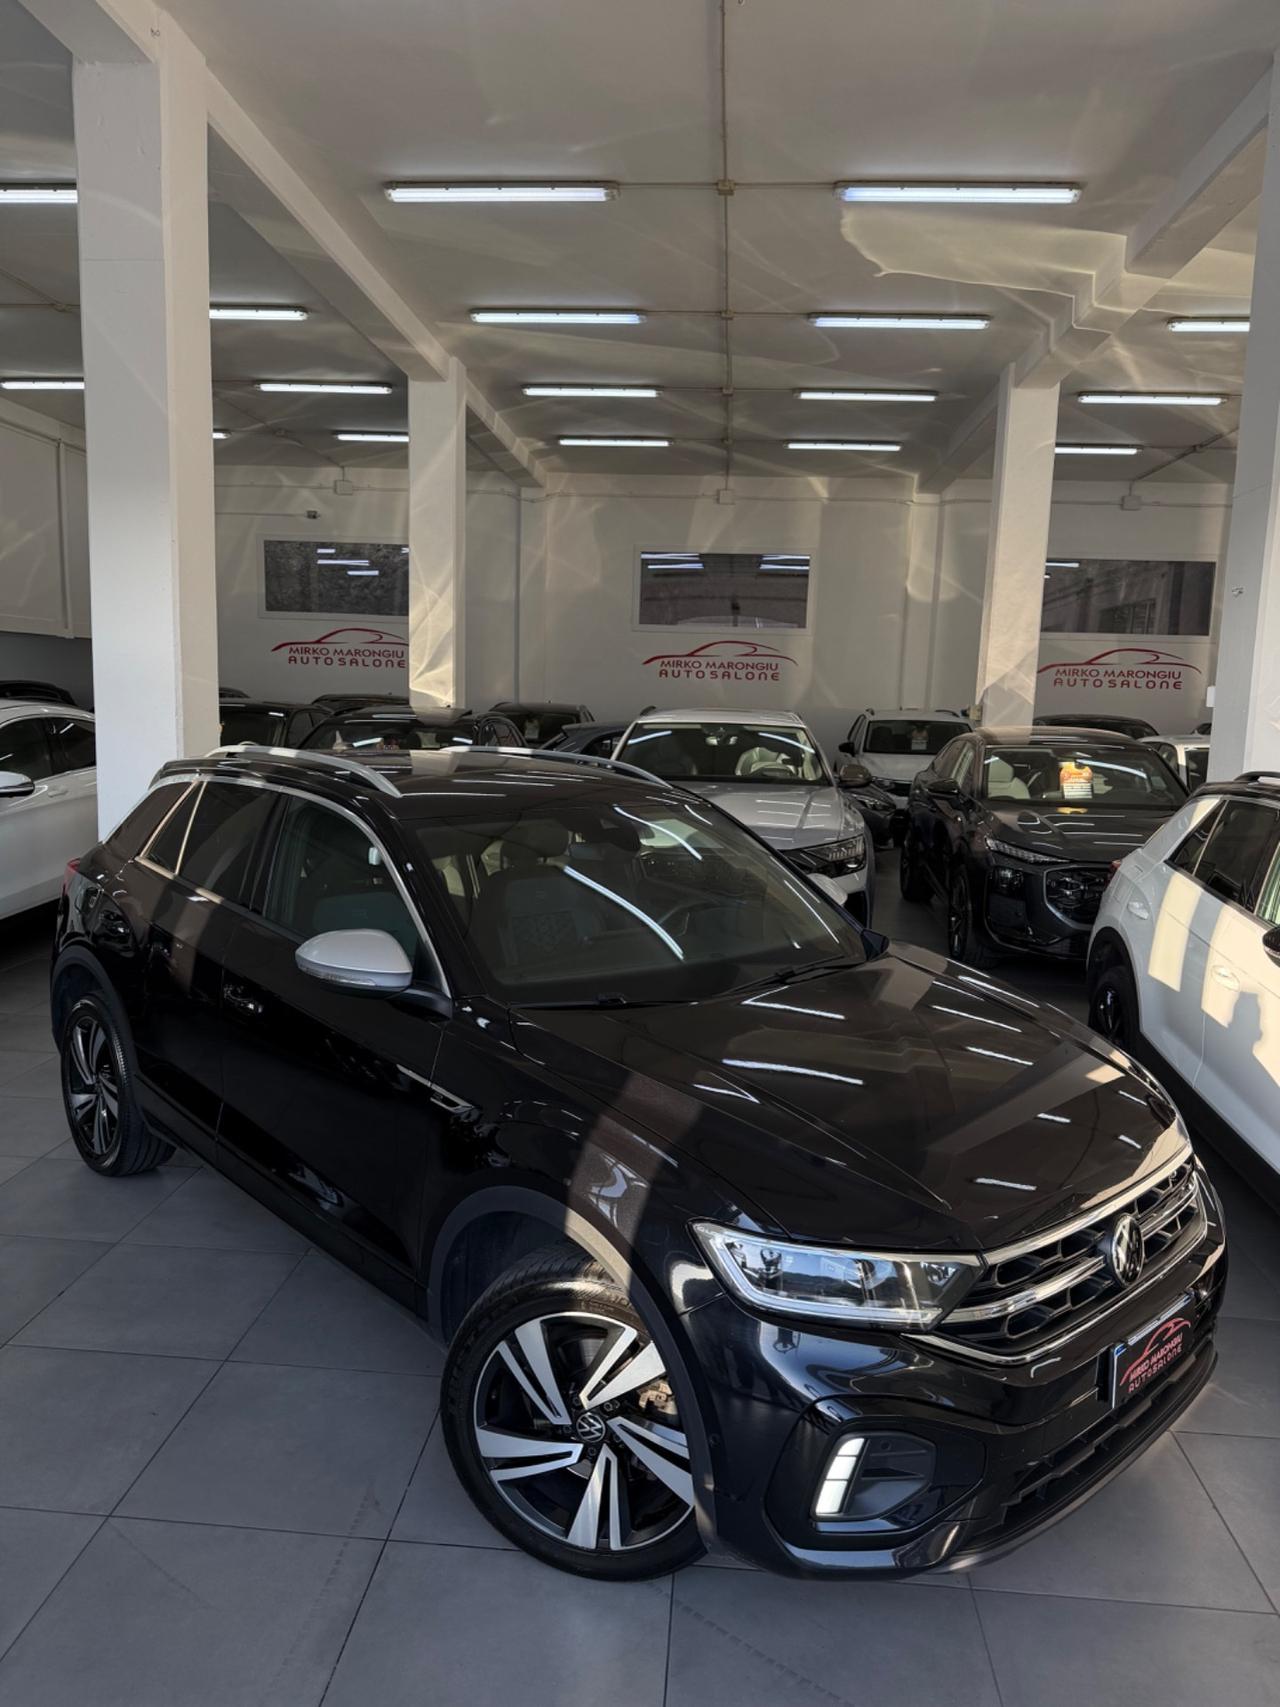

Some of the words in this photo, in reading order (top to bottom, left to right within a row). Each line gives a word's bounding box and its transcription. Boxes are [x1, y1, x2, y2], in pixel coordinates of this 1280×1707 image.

[289, 647, 330, 655] MIRKO
[333, 648, 404, 658] MARONGIU
[288, 656, 407, 668] AUTOSALONE
[660, 660, 702, 669] MIRKO
[705, 662, 779, 671] MARONGIU
[659, 669, 780, 681] AUTOSALONE
[1055, 668, 1099, 678] MIRKO
[1103, 670, 1182, 679] MARONGIU
[1053, 678, 1183, 690] AUTOSALONE
